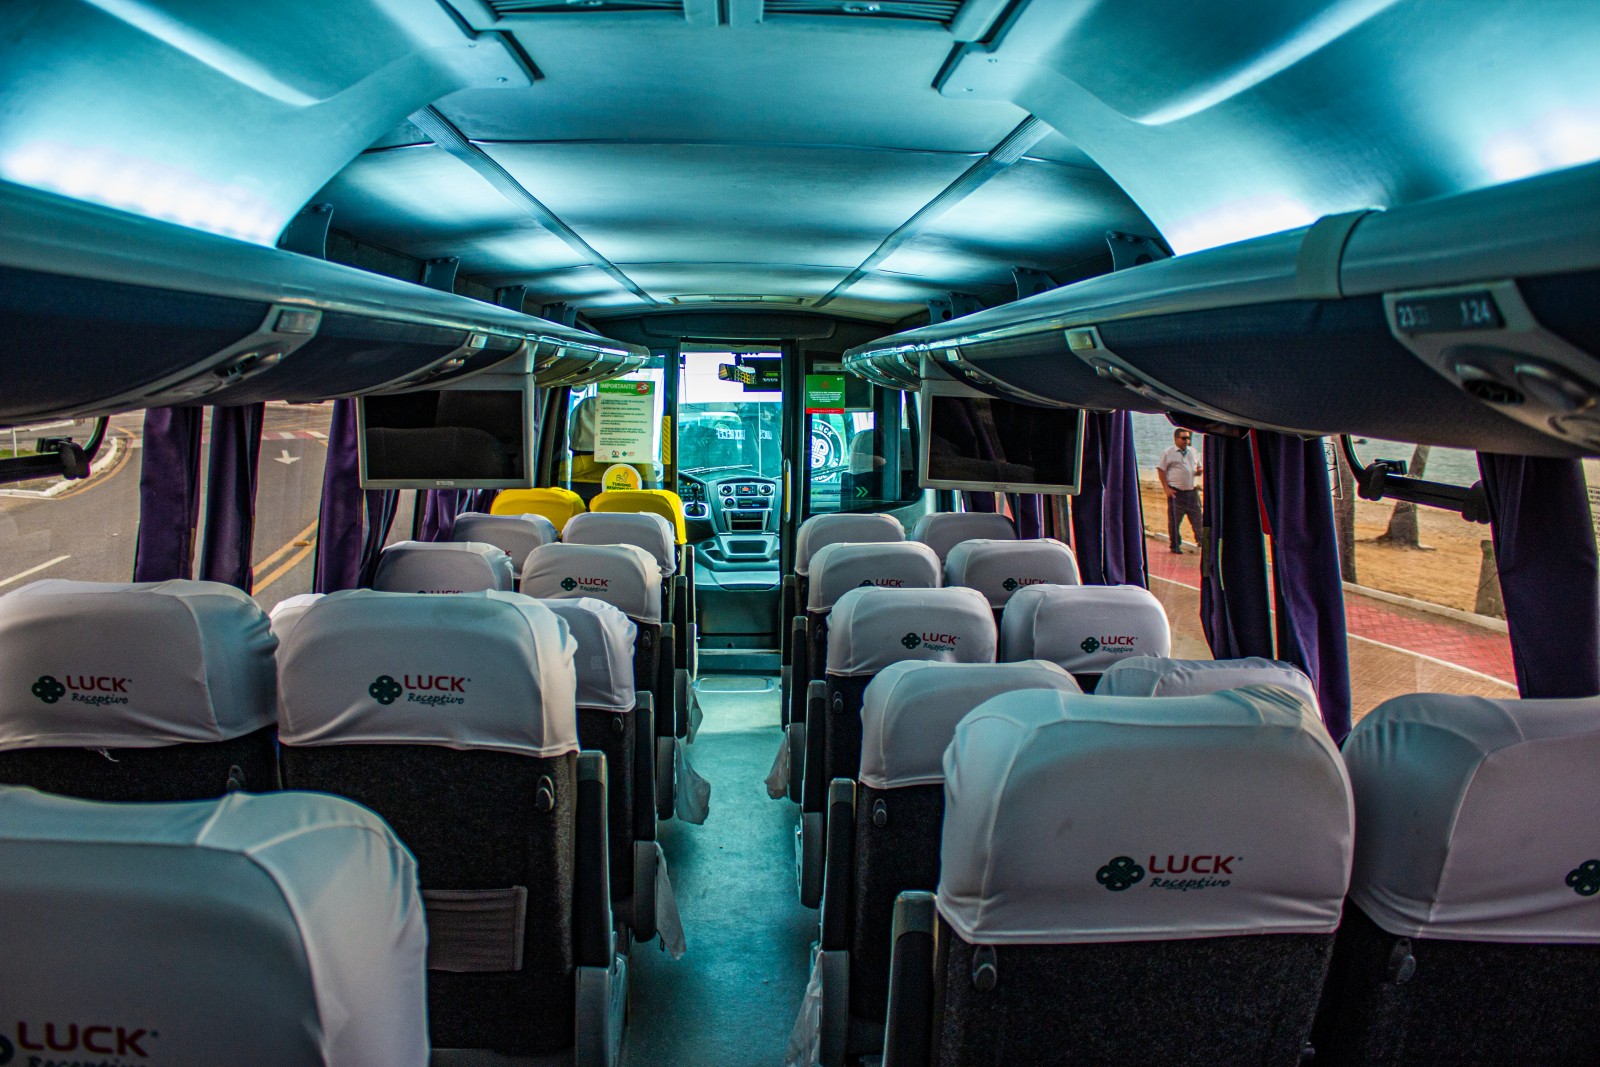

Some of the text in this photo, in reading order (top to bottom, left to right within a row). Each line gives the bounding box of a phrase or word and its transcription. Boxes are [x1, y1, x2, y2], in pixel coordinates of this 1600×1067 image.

[814, 423, 834, 437] LUCK
[577, 577, 609, 587] LUCK
[875, 578, 903, 588] LUCK
[922, 632, 957, 645] LUCK
[1100, 635, 1135, 646] LUCK
[66, 675, 128, 693] LUCK
[404, 674, 465, 693] LUCK
[71, 692, 129, 707] Receptivo
[407, 692, 465, 707] Receptivo
[1149, 854, 1235, 874] LUCK
[1150, 875, 1231, 892] Receptivo
[17, 1021, 149, 1058] LUCK
